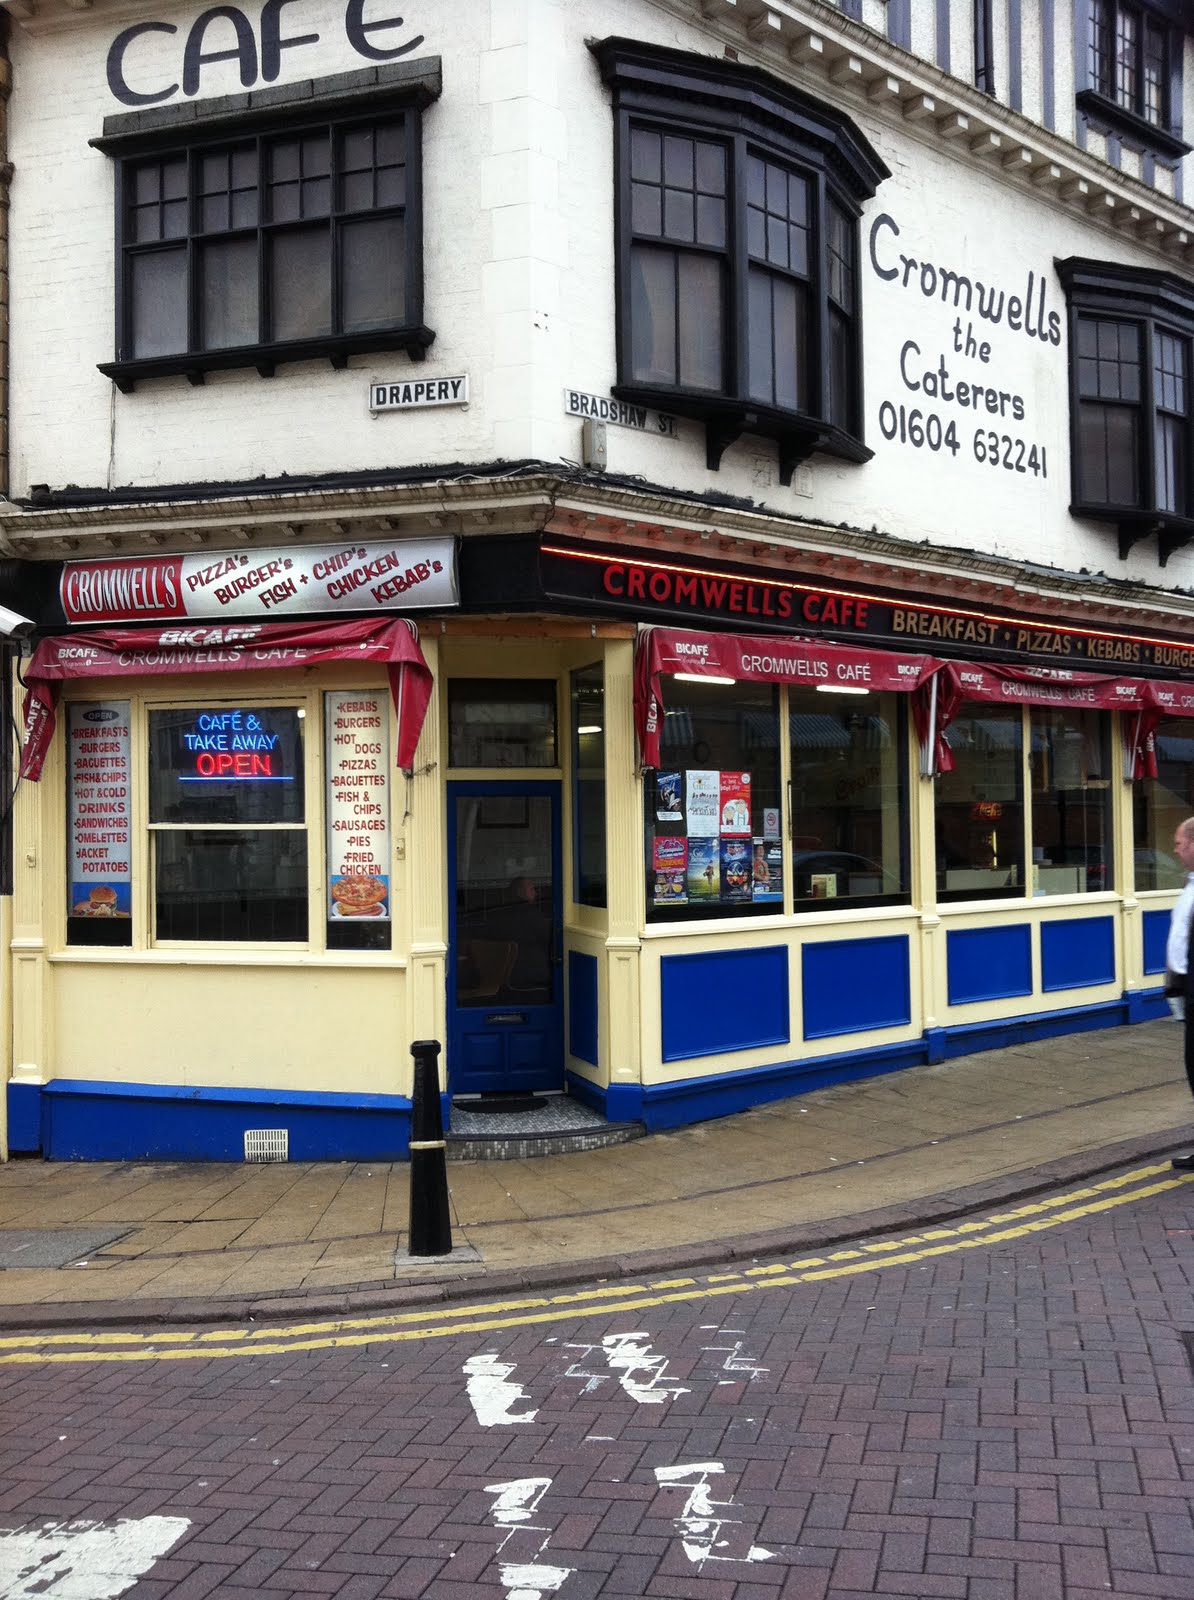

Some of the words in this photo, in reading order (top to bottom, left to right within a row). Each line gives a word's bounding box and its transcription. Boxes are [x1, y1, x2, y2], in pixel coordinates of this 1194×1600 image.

[106, 0, 425, 106] CAFE
[869, 213, 1061, 347] Cromwells
[953, 317, 992, 363] the
[900, 340, 1025, 420] Caterers
[376, 380, 462, 405] DRAPERY
[570, 392, 648, 429] BRADSHAW
[658, 413, 674, 435] ST
[879, 400, 961, 457] 01604
[973, 428, 1048, 478] 632241
[327, 551, 400, 600] CHICKEN
[67, 565, 178, 613] CROMWELL'S
[258, 578, 298, 609] FISH
[603, 565, 793, 618] CROMWELLS
[803, 594, 869, 628] CAFE
[892, 610, 999, 645] BREAKFAST
[1017, 630, 1072, 655] PIZZAS
[1087, 638, 1141, 662] KEBABS
[741, 655, 829, 677] CROMWELL'S
[837, 662, 872, 681] CAFÉ
[339, 701, 378, 713] KEBABS
[88, 711, 113, 720] OPEN
[200, 710, 243, 731] CAFÉ
[246, 714, 262, 731] &
[337, 716, 382, 728] BURGERS
[73, 726, 129, 739] BREAKFASTS
[184, 733, 229, 751] TAKE
[232, 734, 279, 751] AWAY
[336, 734, 357, 745] HOT
[81, 742, 121, 753] BURGERS
[355, 742, 382, 754] DOGS
[76, 757, 127, 768] BAGUETTES
[196, 752, 273, 776] OPEN
[341, 759, 377, 770] PIZZAS
[333, 775, 386, 787] BAGUETTES
[77, 788, 95, 799] HOT
[338, 791, 360, 802] FISH
[363, 791, 370, 802] &
[79, 802, 125, 813] DRINKS
[353, 804, 382, 815] CHIPS
[76, 817, 129, 829] SANDWICHES
[334, 820, 386, 831] SAUSAGES
[77, 833, 128, 843] OMELETTES
[349, 836, 371, 847] PIES
[77, 848, 109, 859] JACKET
[346, 852, 374, 863] FRIED
[83, 862, 129, 873] POTATOES
[340, 864, 382, 875] CHICKEN
